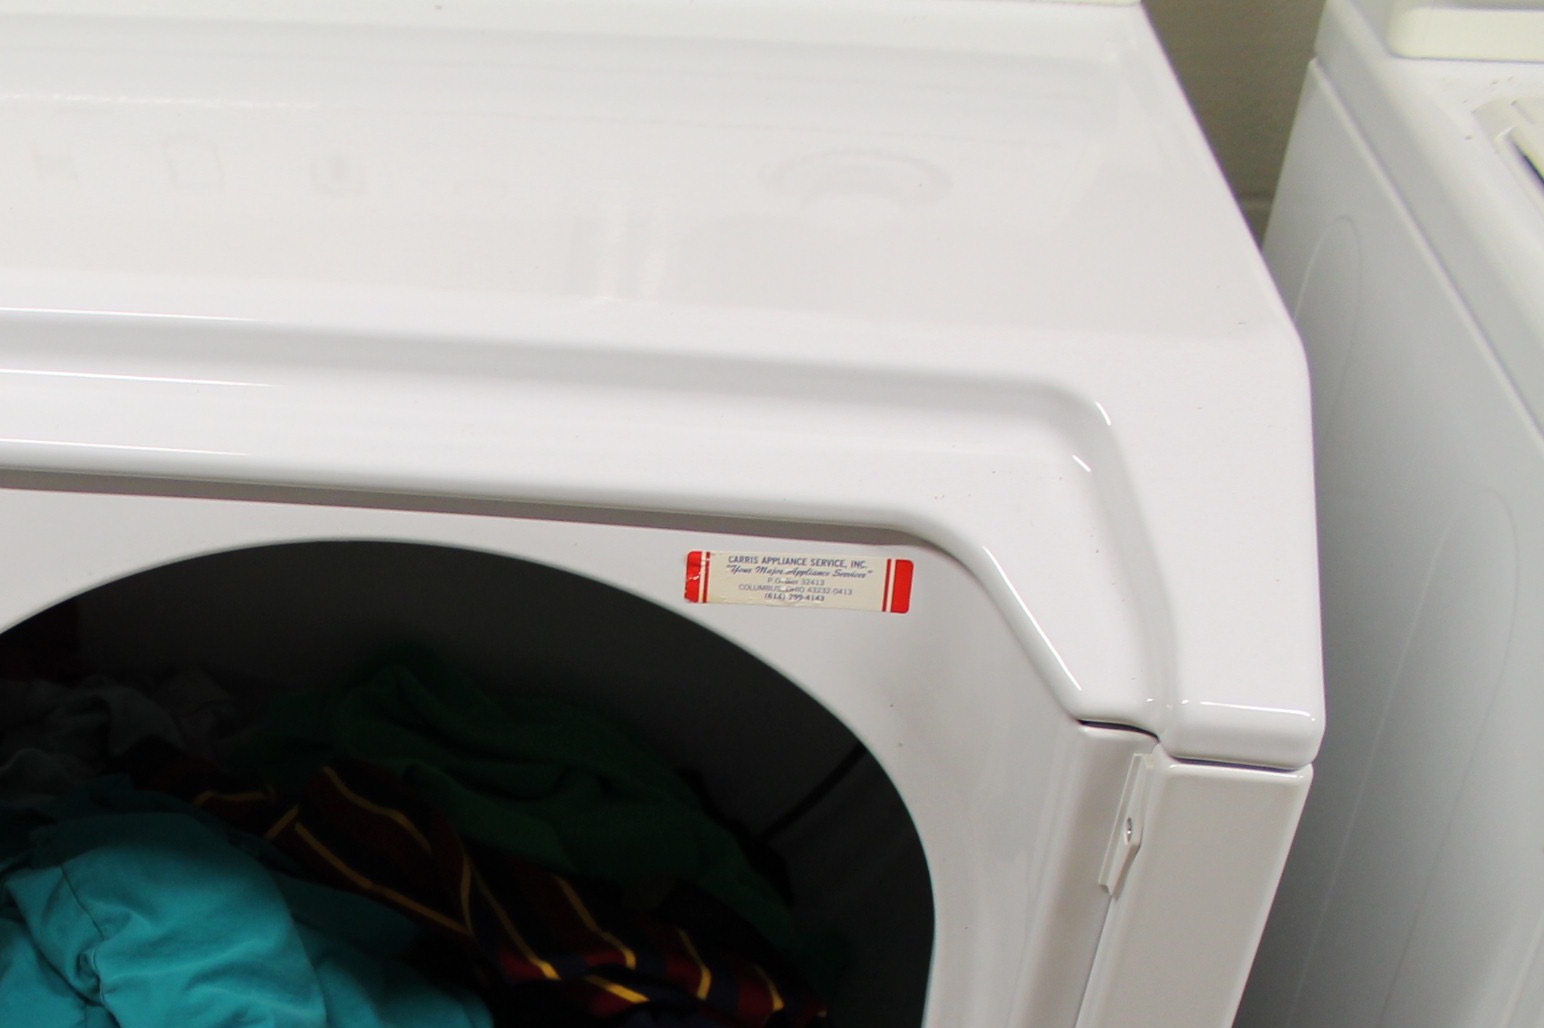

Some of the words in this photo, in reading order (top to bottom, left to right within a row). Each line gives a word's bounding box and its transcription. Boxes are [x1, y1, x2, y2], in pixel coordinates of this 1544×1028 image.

[728, 555, 758, 564] CARRIS
[761, 556, 807, 567] APPLIANCE
[811, 559, 848, 569] SERVICE,
[850, 560, 868, 569] INC.
[755, 566, 784, 577] Major
[784, 566, 830, 578] Appliance
[764, 592, 786, 601] (614)
